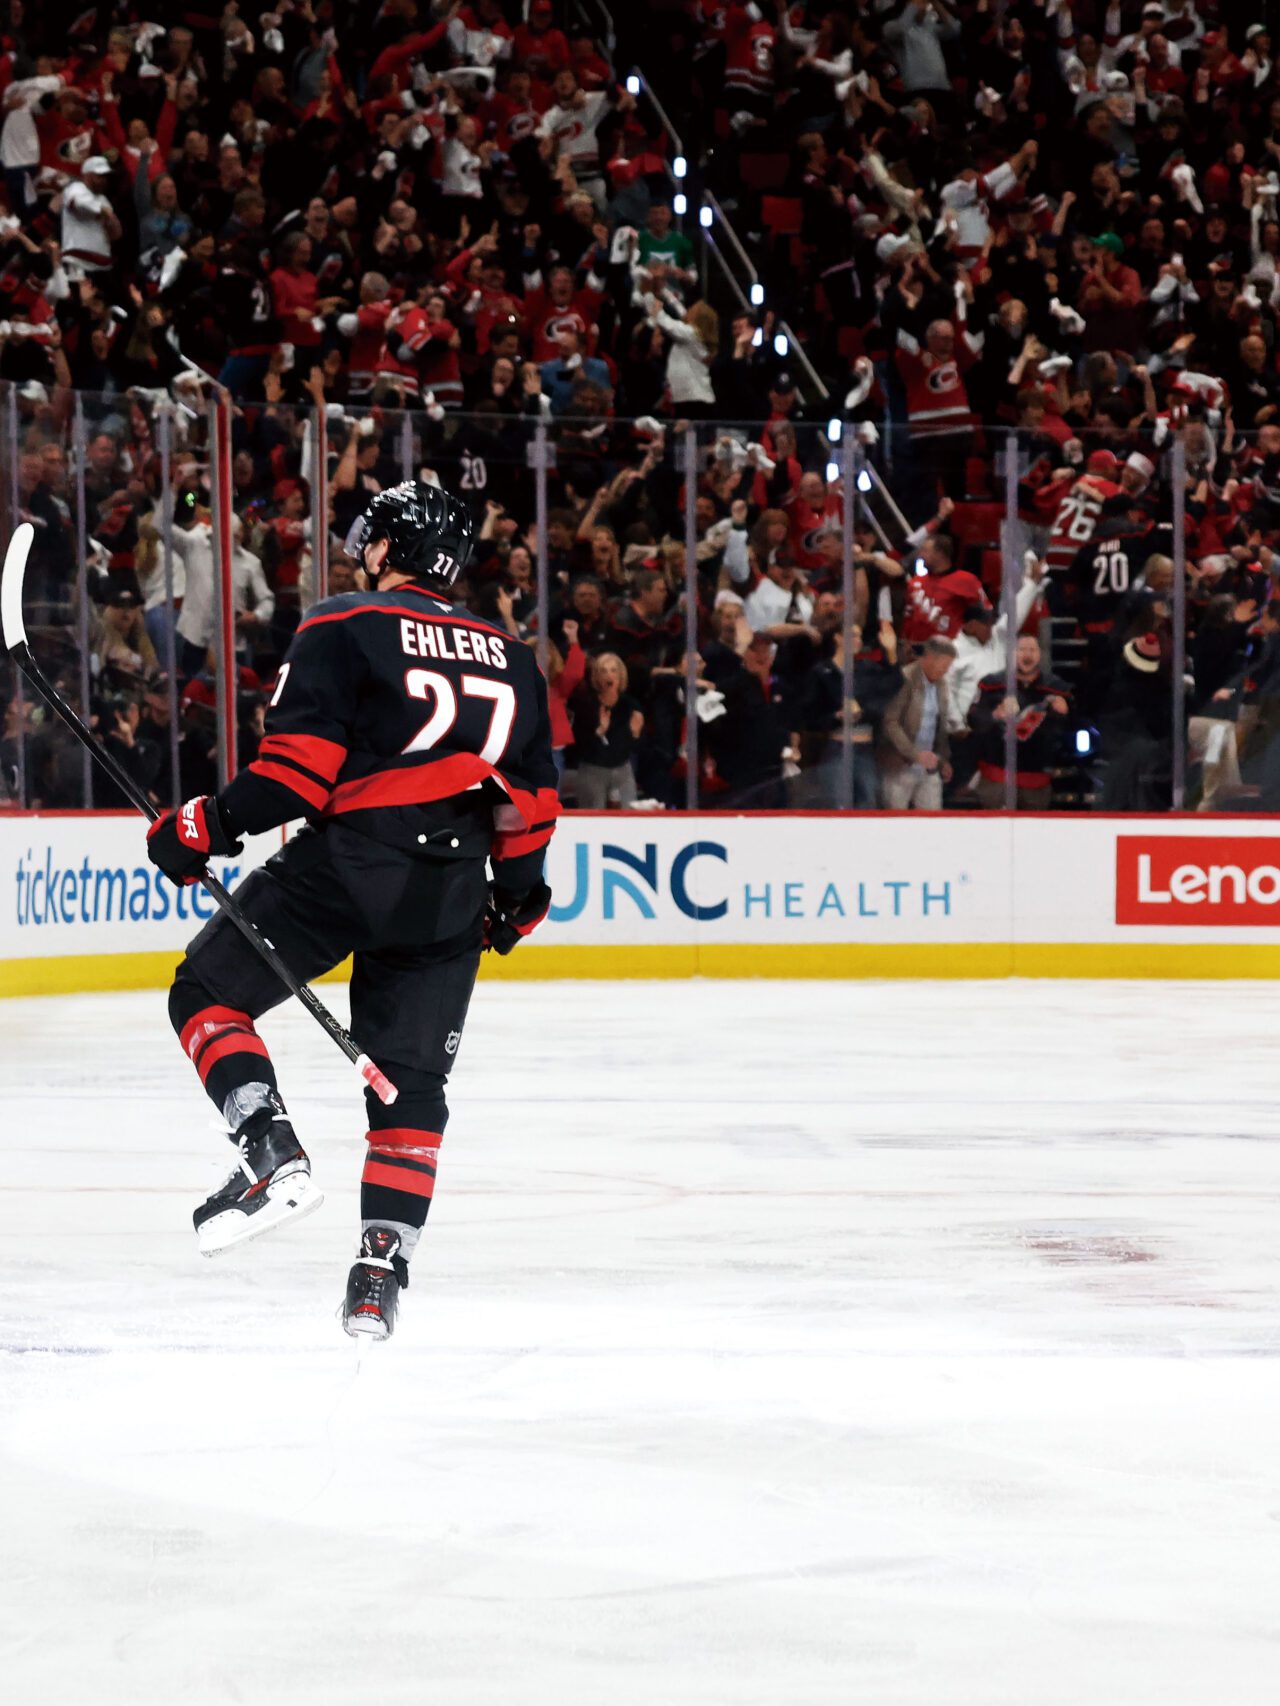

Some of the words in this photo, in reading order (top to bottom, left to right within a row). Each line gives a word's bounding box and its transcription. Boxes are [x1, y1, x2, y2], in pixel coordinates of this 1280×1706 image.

[433, 552, 454, 576] 27
[1093, 553, 1129, 595] 20
[400, 618, 508, 669] EHLERS
[401, 668, 517, 766] 27
[543, 841, 728, 922] UNC
[744, 881, 952, 918] HEALTH
